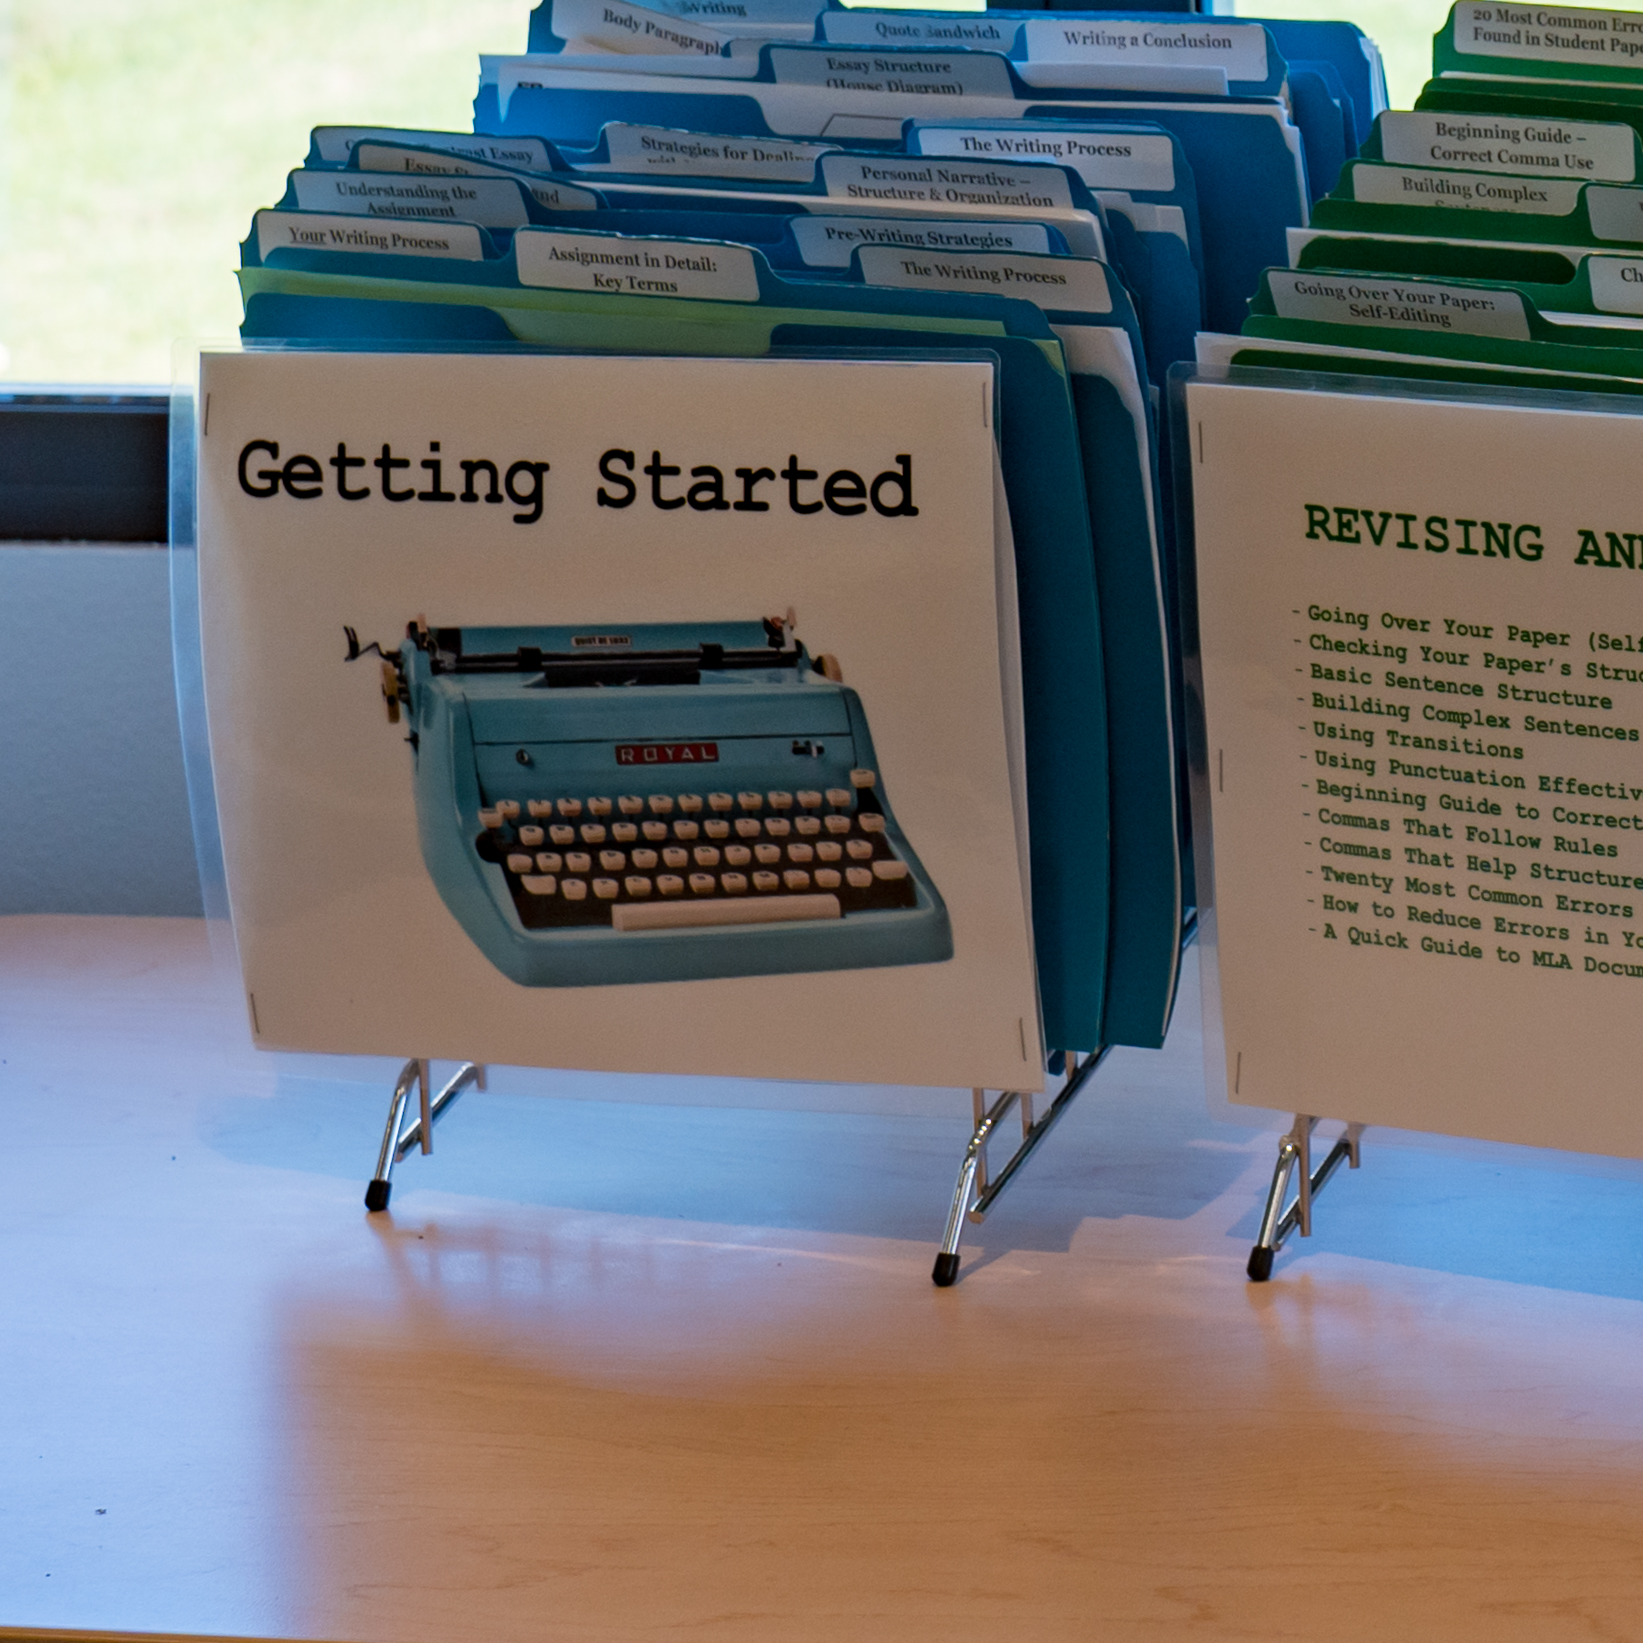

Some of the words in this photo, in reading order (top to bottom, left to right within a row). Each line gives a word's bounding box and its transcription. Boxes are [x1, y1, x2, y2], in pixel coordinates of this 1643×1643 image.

[1474, 9, 1492, 21] 20
[1496, 10, 1532, 25] Most
[1537, 12, 1607, 30] Common
[1064, 31, 1126, 49] Writing
[1131, 37, 1138, 46] a
[1143, 33, 1231, 48] Conclusion
[1474, 27, 1521, 44] Found
[1526, 31, 1540, 45] in
[1545, 34, 1605, 51] Student
[1436, 122, 1520, 143] Beginning
[1524, 128, 1571, 143] Guide
[1431, 146, 1492, 162] Correct
[1498, 150, 1559, 167] Comma
[1565, 154, 1593, 169] Use
[289, 227, 326, 244] Your
[330, 230, 388, 249] Writing
[392, 233, 449, 250] Process
[549, 247, 640, 266] Assignment
[645, 252, 660, 267] in
[665, 256, 716, 272] Detail:
[594, 274, 622, 288] Key
[626, 276, 677, 292] Terms
[1295, 282, 1346, 300] Going
[1348, 286, 1389, 300] Over
[1393, 289, 1435, 304] Your
[1440, 293, 1494, 311] Paper:
[1349, 304, 1451, 328] Self-Editing
[238, 440, 550, 524] Getting
[597, 449, 919, 517] Started
[1305, 504, 1544, 561] REVISING
[1308, 605, 1369, 630] Going
[1381, 613, 1430, 632] Over
[1444, 619, 1493, 638] Your
[1508, 625, 1570, 648] Paper
[1310, 634, 1407, 664] Checking
[1420, 646, 1469, 665] Your
[1484, 653, 1571, 676] Paper's
[1311, 663, 1371, 684] Basic
[1386, 672, 1483, 696] Sentence
[1498, 684, 1612, 709] Structure
[1312, 692, 1410, 722] Building
[1423, 705, 1510, 729] Complex
[1525, 716, 1639, 741] Sentences
[620, 746, 716, 763] ROYAL
[1314, 721, 1374, 747] Using
[1387, 730, 1523, 759] Transitions
[1315, 750, 1376, 776] Using
[1389, 759, 1525, 789] Punctuation
[1317, 779, 1426, 811] Beginning
[1440, 794, 1501, 815] Guide
[1516, 803, 1539, 819] to
[1553, 807, 1643, 830] Correct
[1319, 808, 1390, 831] Commas
[1403, 819, 1453, 839] That
[1466, 826, 1541, 849] Follow
[1554, 836, 1618, 857] Rules
[1321, 866, 1393, 894] Twenty
[1405, 877, 1455, 897] Most
[1468, 885, 1543, 908] Common
[1556, 895, 1633, 917] Errors
[1324, 923, 1337, 939] A
[1348, 927, 1409, 949] Quick
[1421, 937, 1482, 959] Guide
[1497, 947, 1520, 963] to
[1533, 951, 1572, 969] MLA
